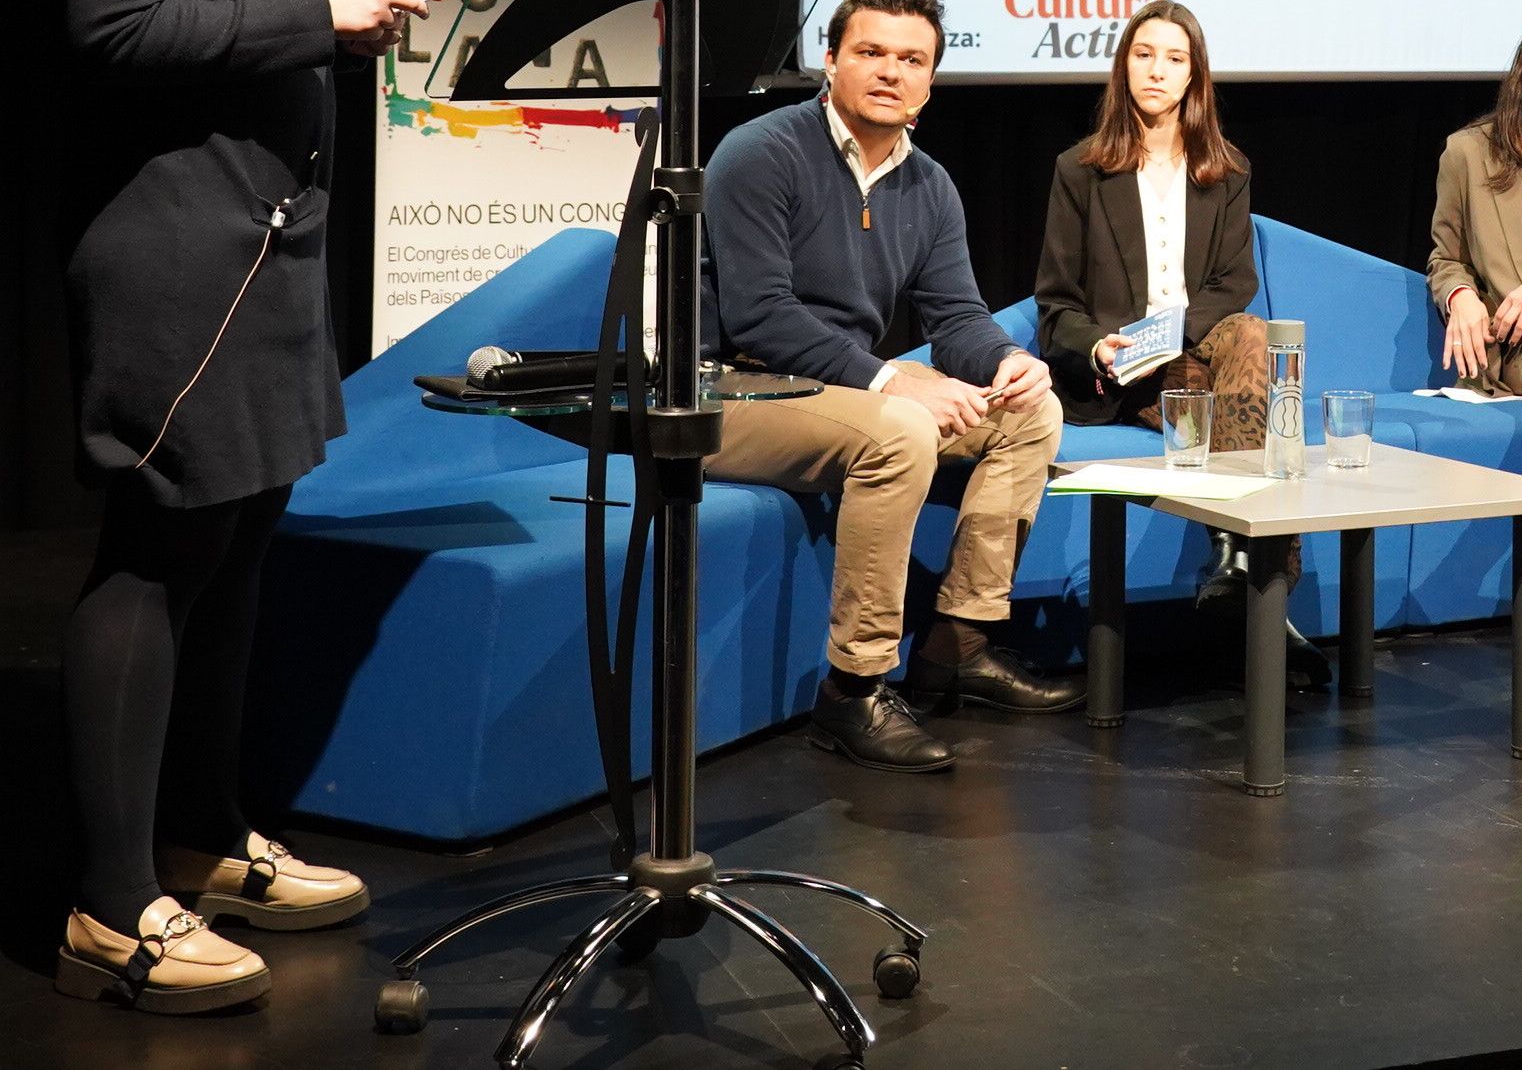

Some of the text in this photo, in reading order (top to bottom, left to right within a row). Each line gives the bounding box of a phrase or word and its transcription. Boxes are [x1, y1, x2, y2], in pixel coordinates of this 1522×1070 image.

[1032, 21, 1118, 59] Acti
[388, 200, 626, 226] AIXÒ NO ÉS UN CONG
[387, 244, 534, 266] El Congrés de Cult
[387, 267, 460, 284] moviment
[463, 266, 487, 282] de
[387, 290, 417, 306] dels
